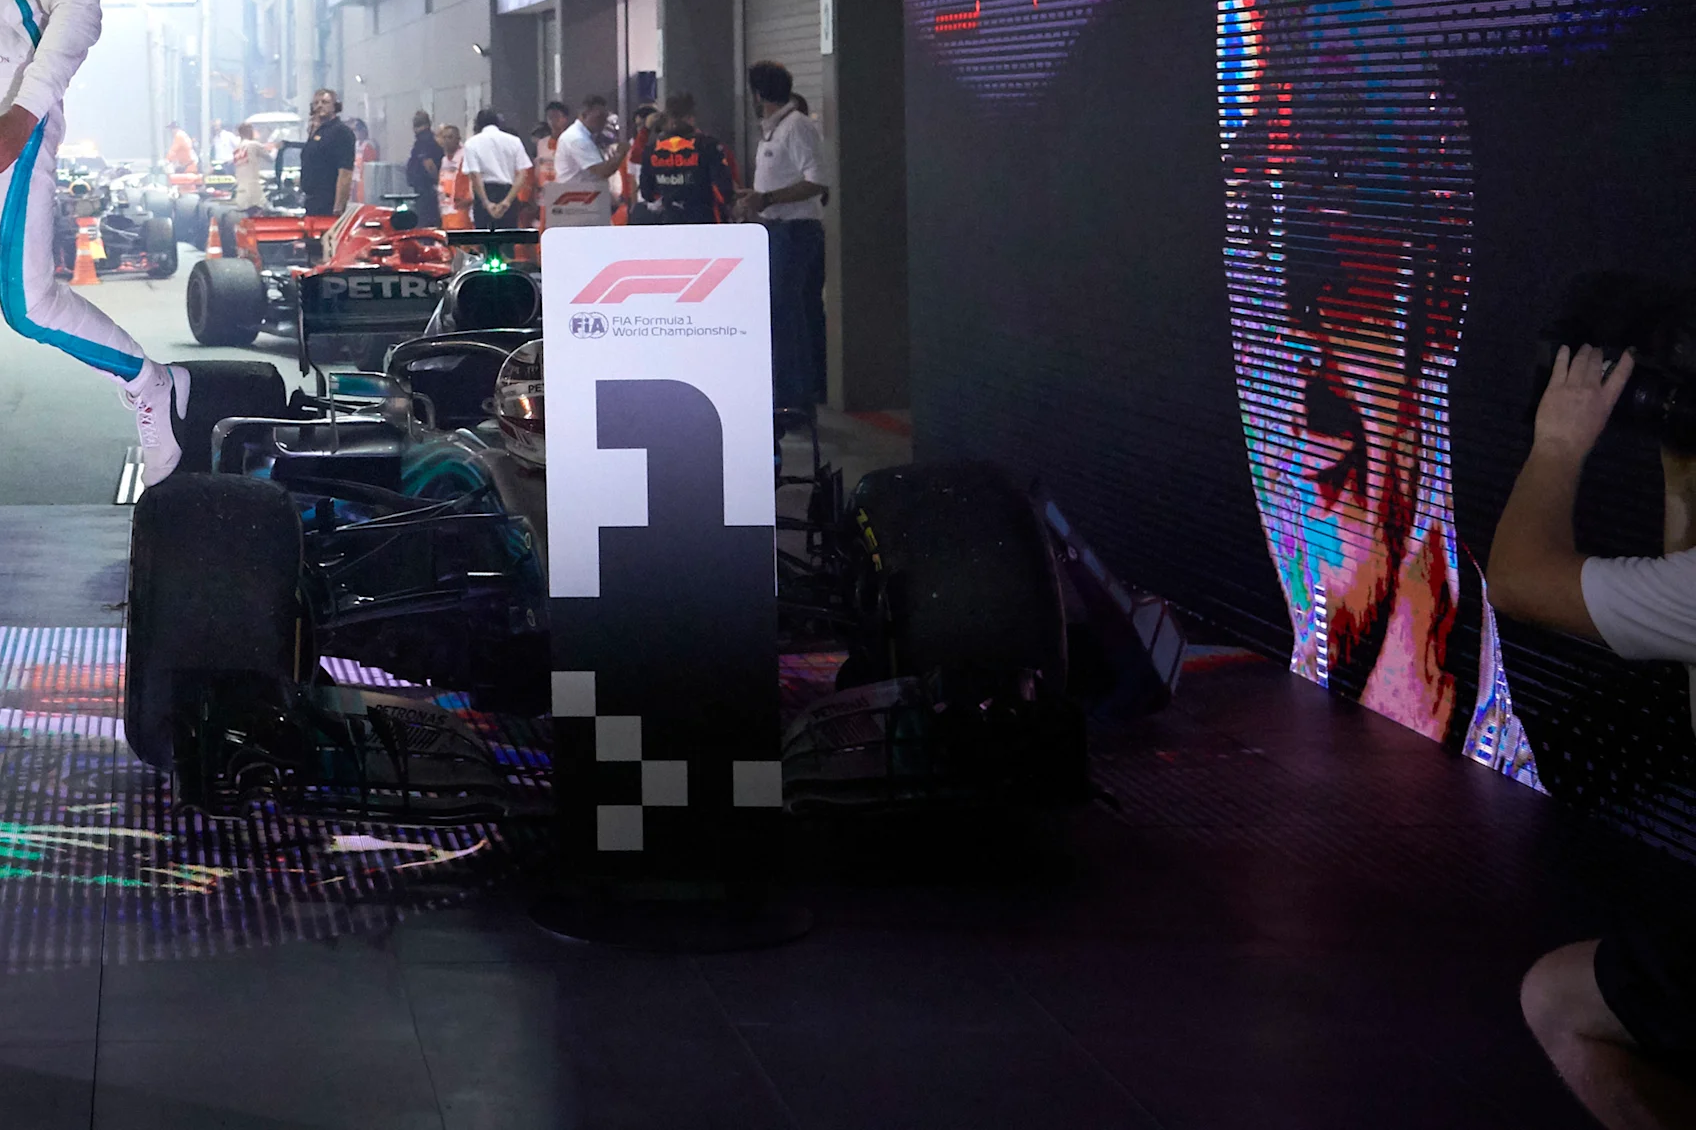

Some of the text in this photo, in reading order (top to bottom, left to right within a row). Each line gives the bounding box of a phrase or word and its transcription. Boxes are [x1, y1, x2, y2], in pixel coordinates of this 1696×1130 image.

[650, 152, 699, 167] Red Bull
[656, 173, 684, 185] Mobil
[612, 315, 633, 326] FIA
[634, 315, 686, 326] Formula
[612, 326, 650, 337] World
[651, 326, 738, 338] Championship
